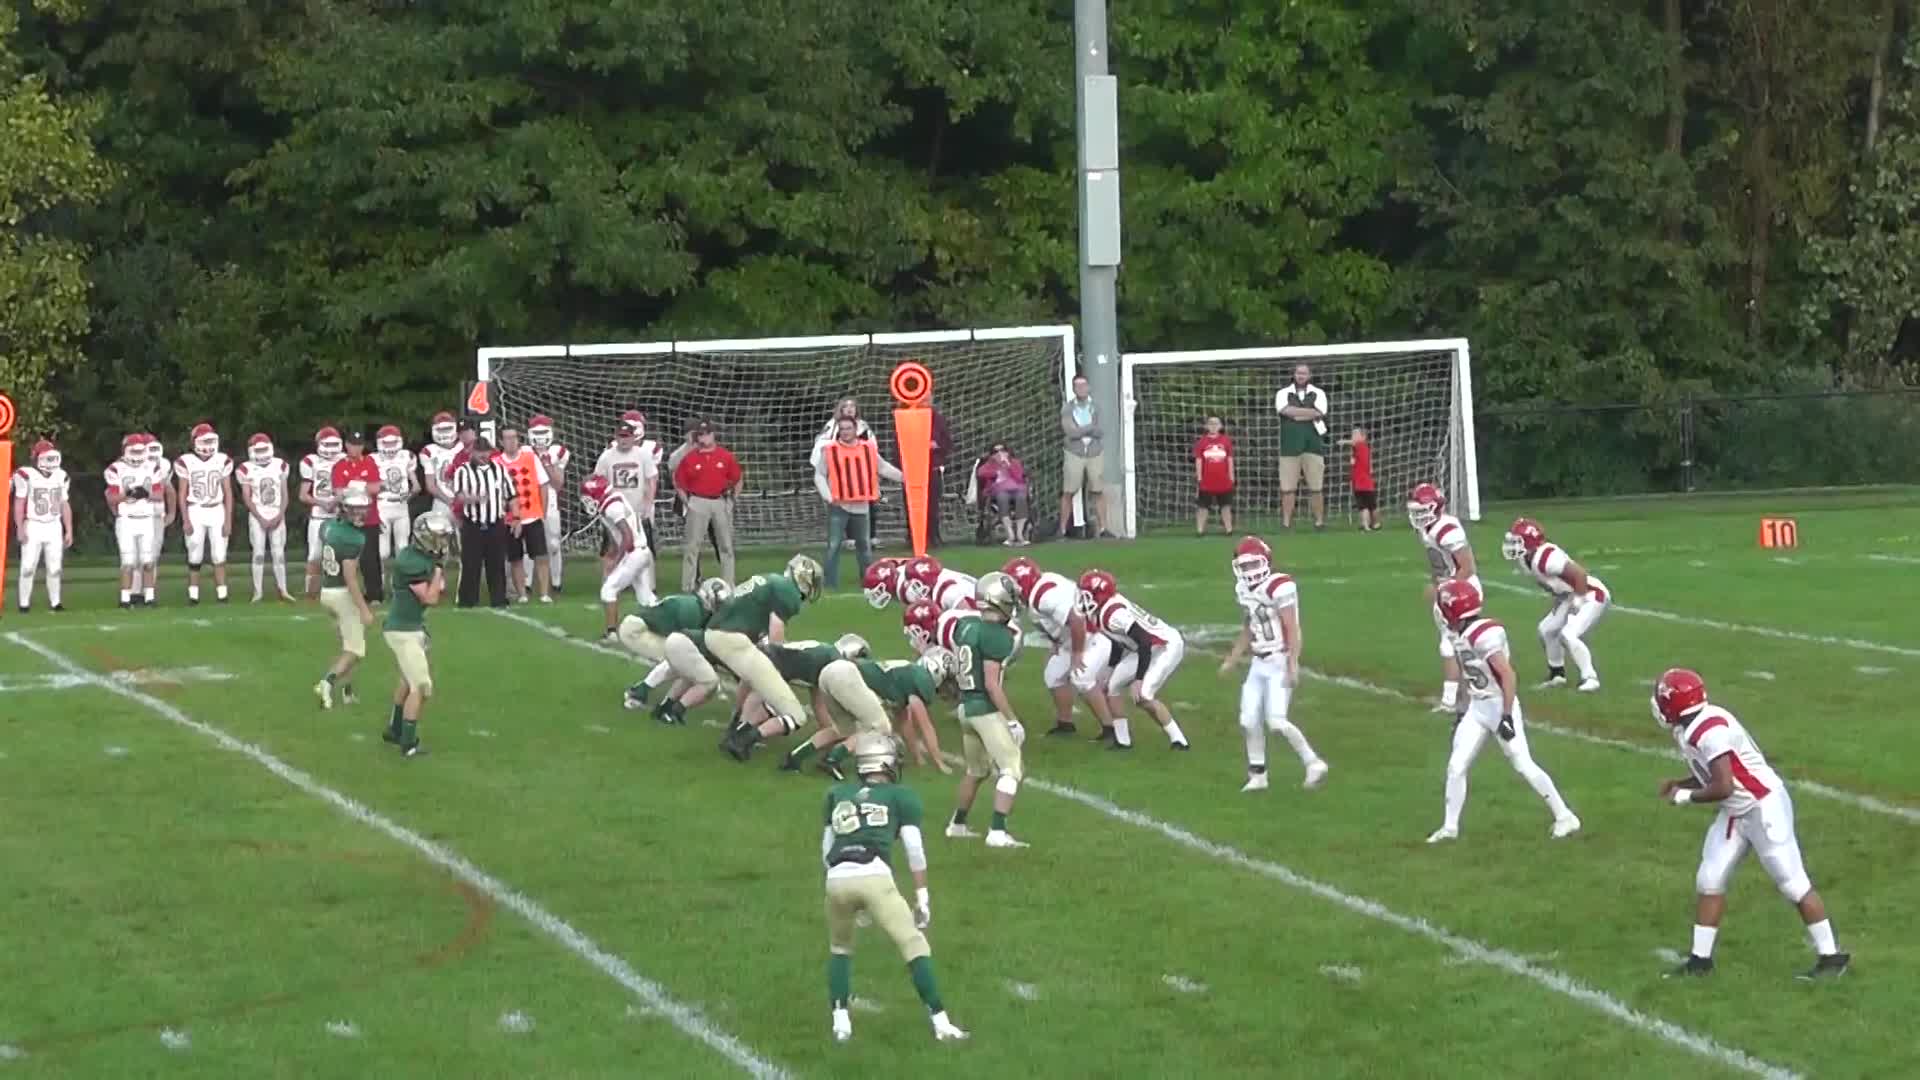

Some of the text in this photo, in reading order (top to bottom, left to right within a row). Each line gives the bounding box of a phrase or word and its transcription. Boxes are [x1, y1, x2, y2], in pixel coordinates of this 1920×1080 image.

[468, 382, 490, 414] 4
[190, 470, 223, 500] 50
[1767, 521, 1795, 548] 10
